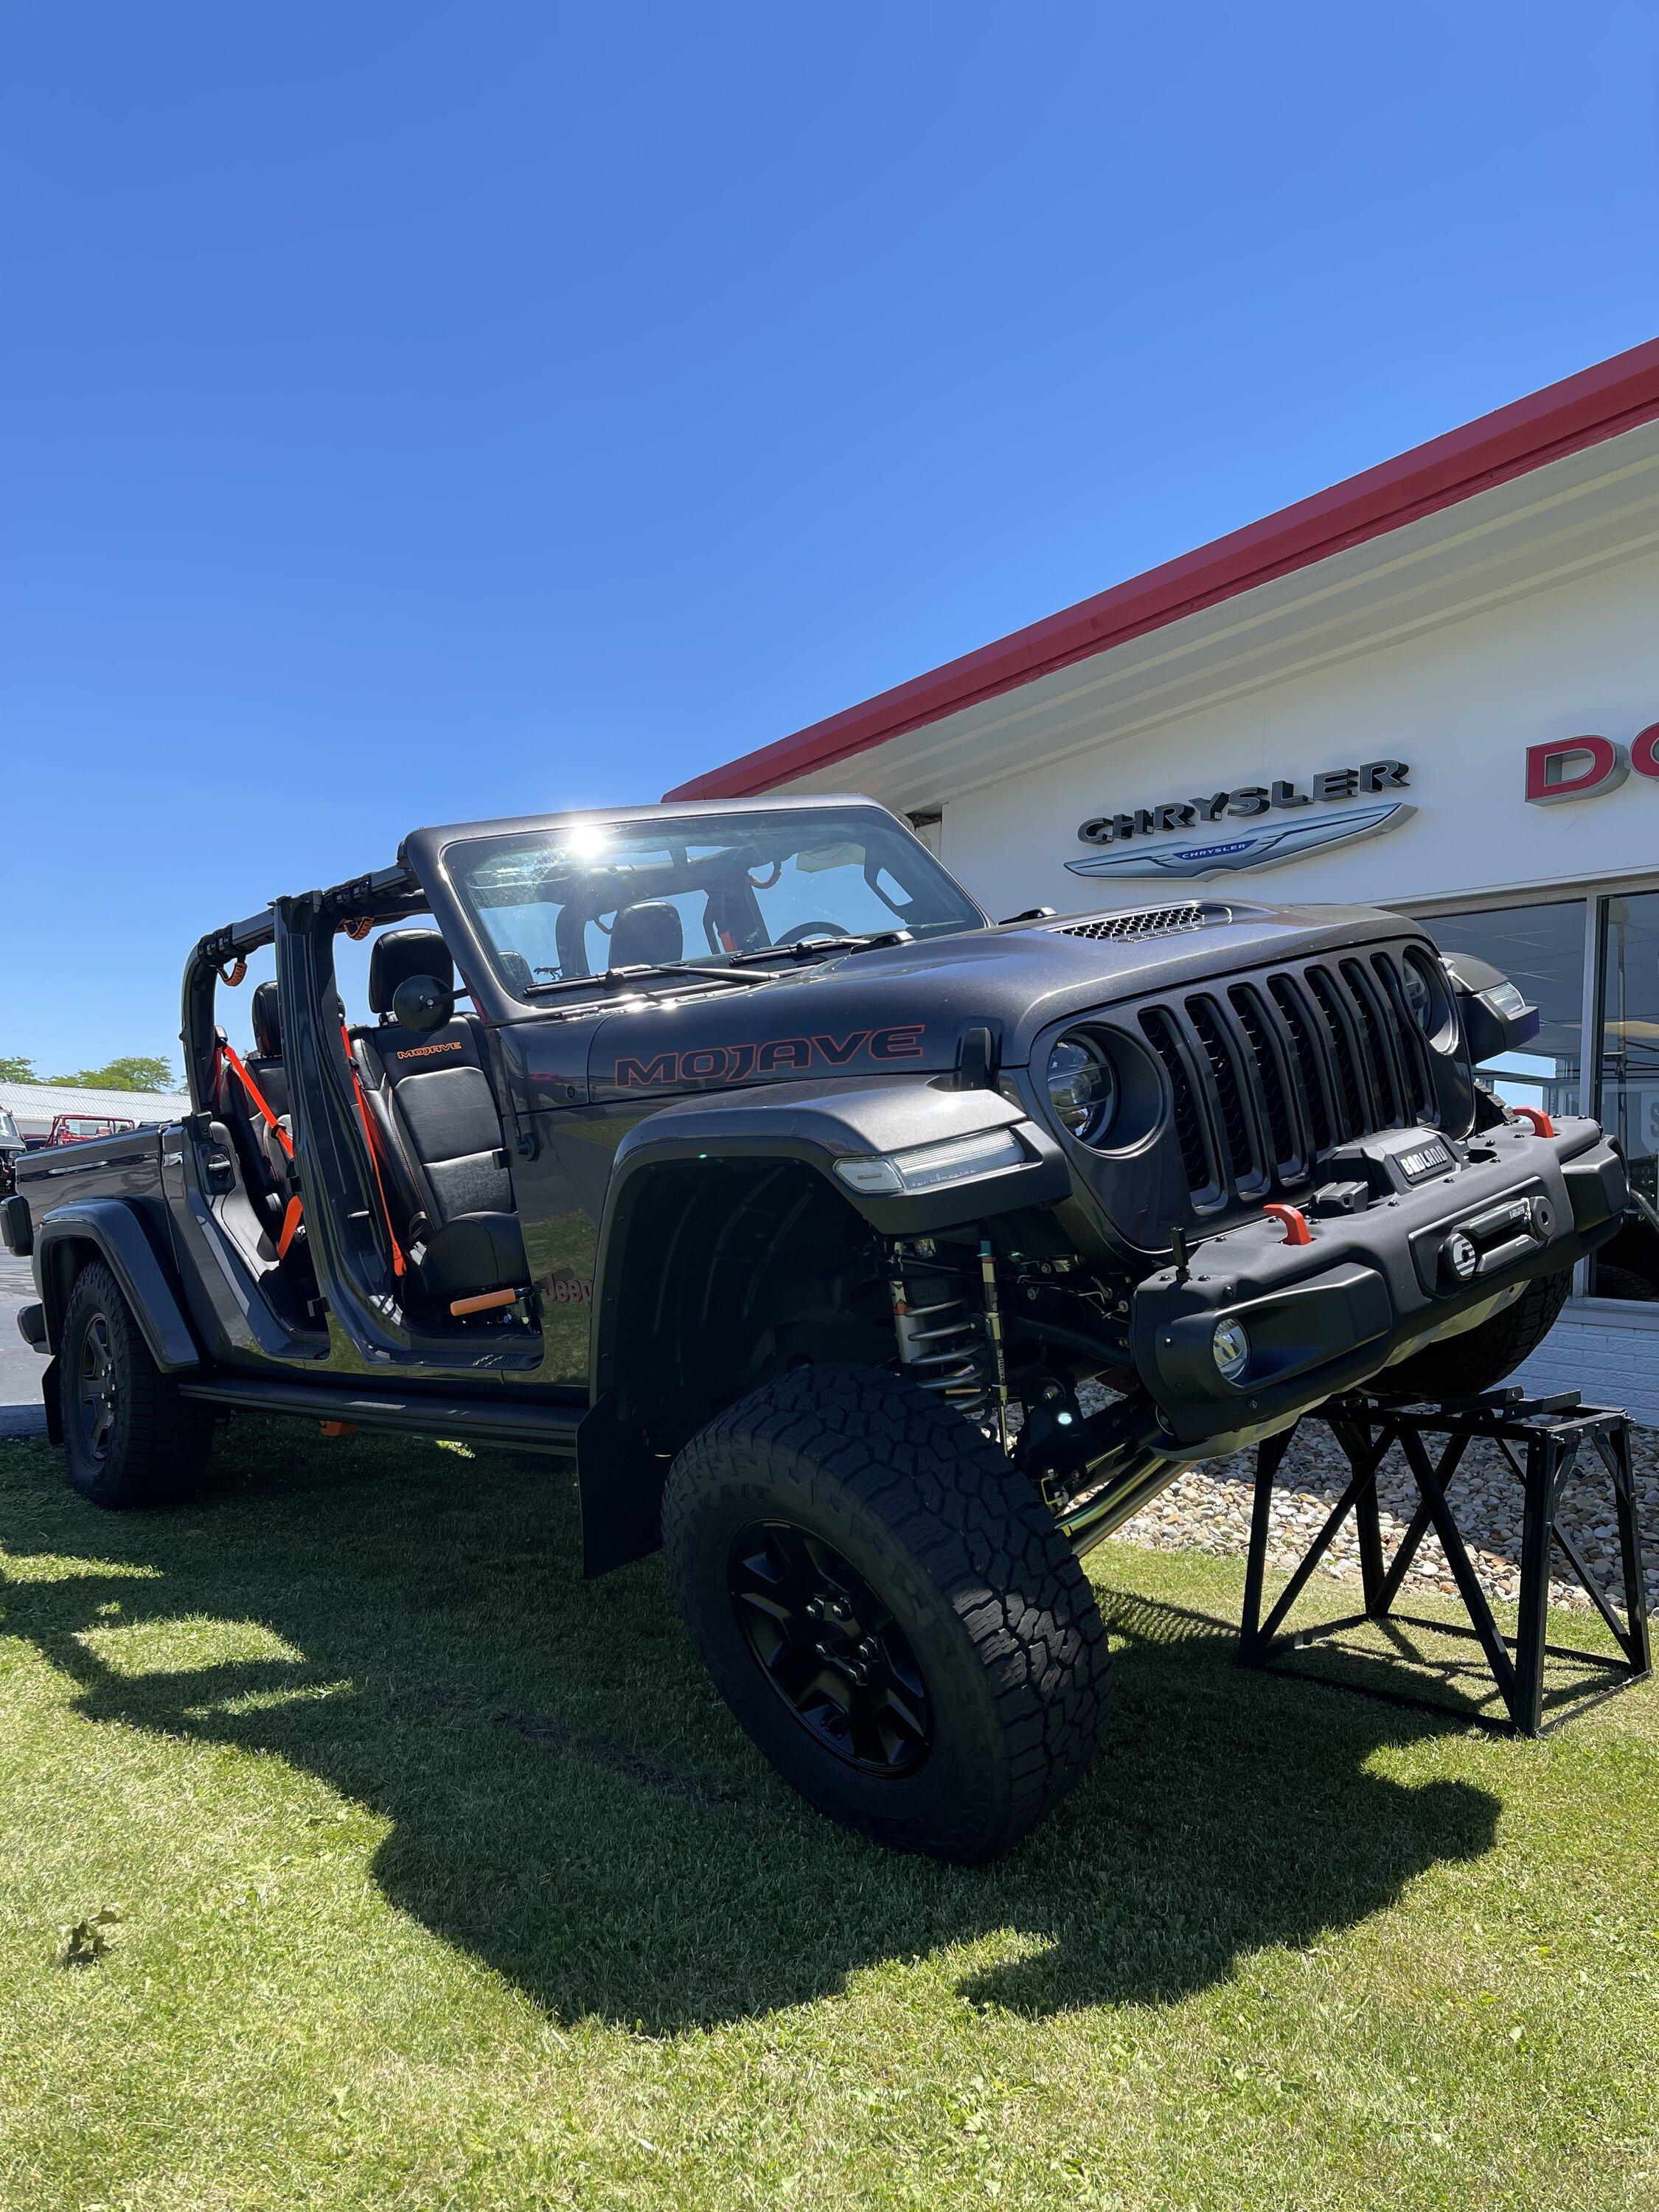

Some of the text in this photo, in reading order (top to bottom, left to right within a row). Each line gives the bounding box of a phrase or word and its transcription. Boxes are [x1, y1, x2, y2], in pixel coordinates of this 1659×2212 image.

[1077, 759, 1411, 844] CHRYSLER
[1182, 844, 1246, 858] CHRYSLER
[397, 1041, 462, 1060] MOJAVE
[615, 1025, 925, 1088] MOJAVE
[1400, 1145, 1448, 1175] BADLAND
